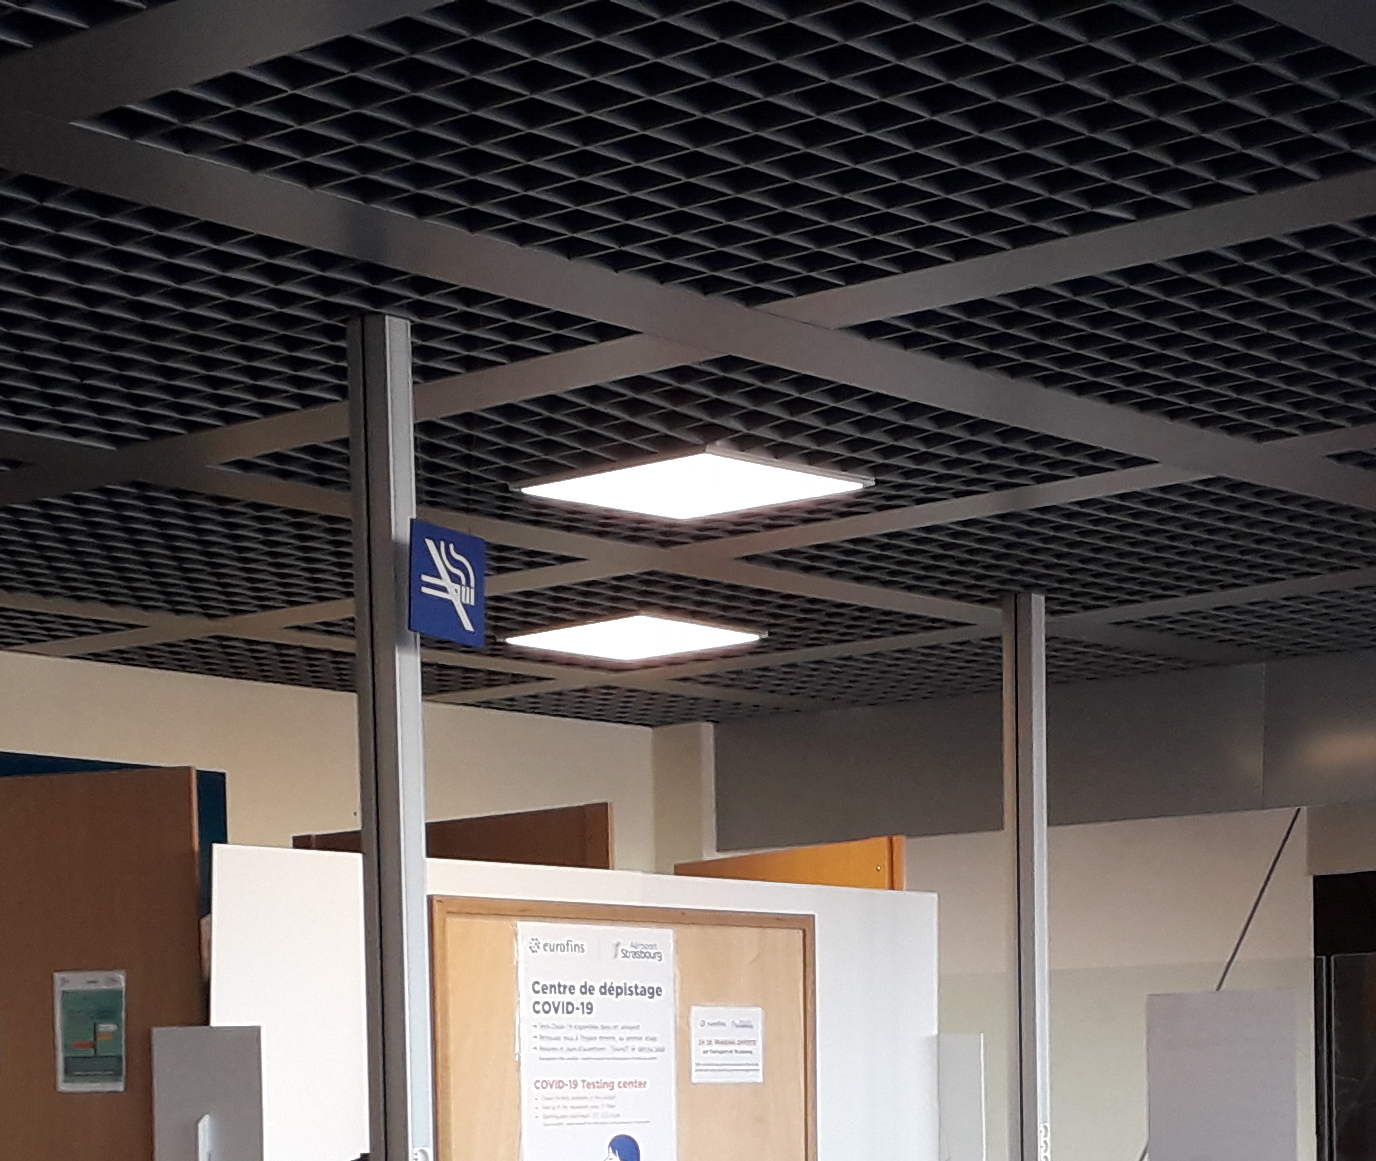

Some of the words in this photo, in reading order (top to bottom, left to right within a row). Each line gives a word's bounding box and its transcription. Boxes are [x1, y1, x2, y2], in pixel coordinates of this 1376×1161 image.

[542, 939, 586, 954] eurofins
[621, 948, 663, 962] Strasbourg
[531, 980, 575, 995] Centre
[579, 981, 596, 996] de
[599, 981, 663, 1000] dépistage
[532, 1000, 594, 1015] COVID-19
[534, 1079, 579, 1090] COVID-19
[580, 1079, 615, 1091] Testing
